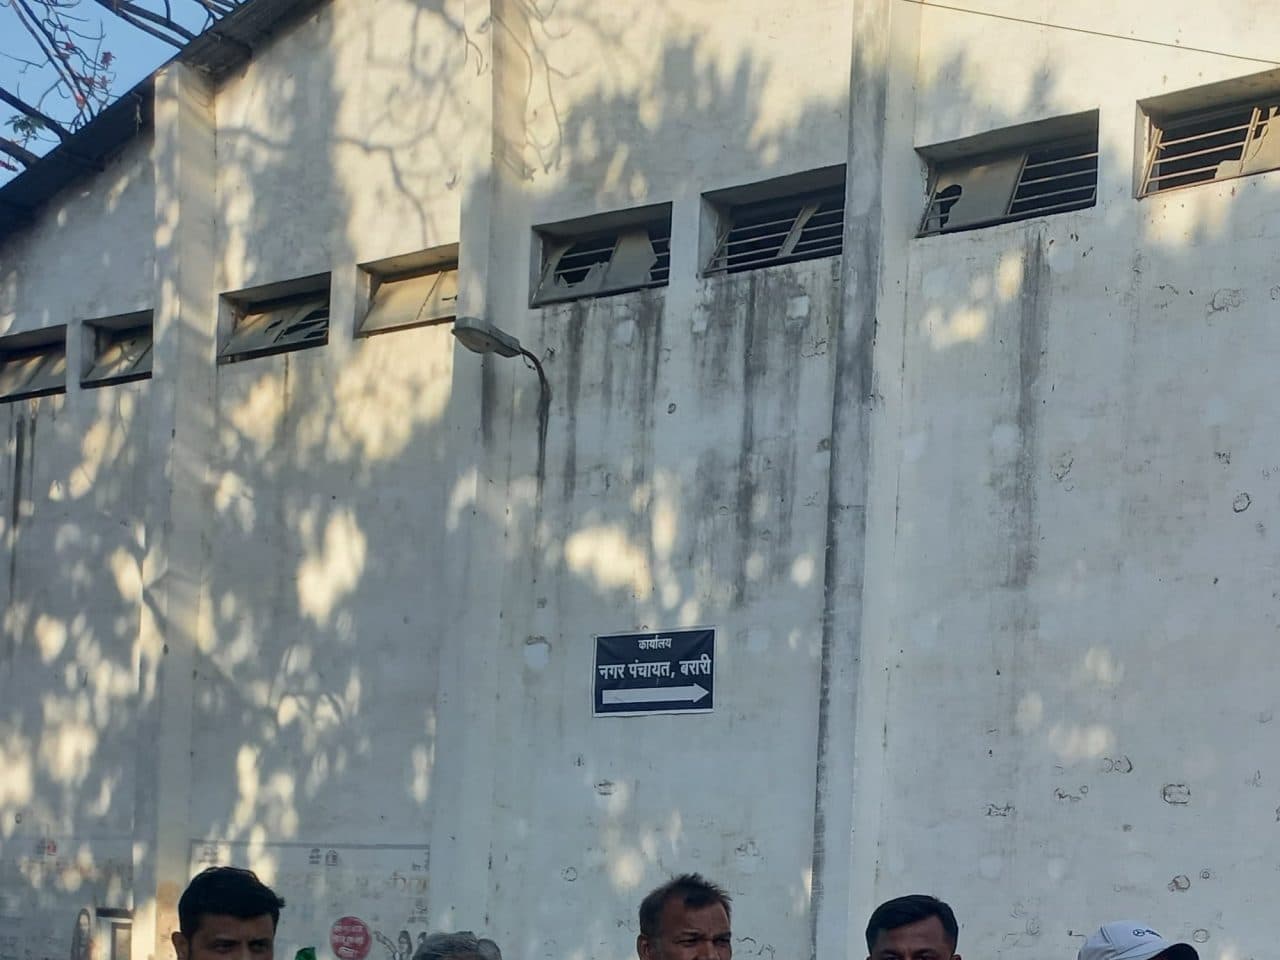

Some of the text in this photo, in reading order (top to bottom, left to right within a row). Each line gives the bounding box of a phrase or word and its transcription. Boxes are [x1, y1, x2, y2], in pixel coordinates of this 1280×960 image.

[638, 635, 672, 650] कार्यालय
[598, 653, 711, 679] नगर पंचायत, बरारी
